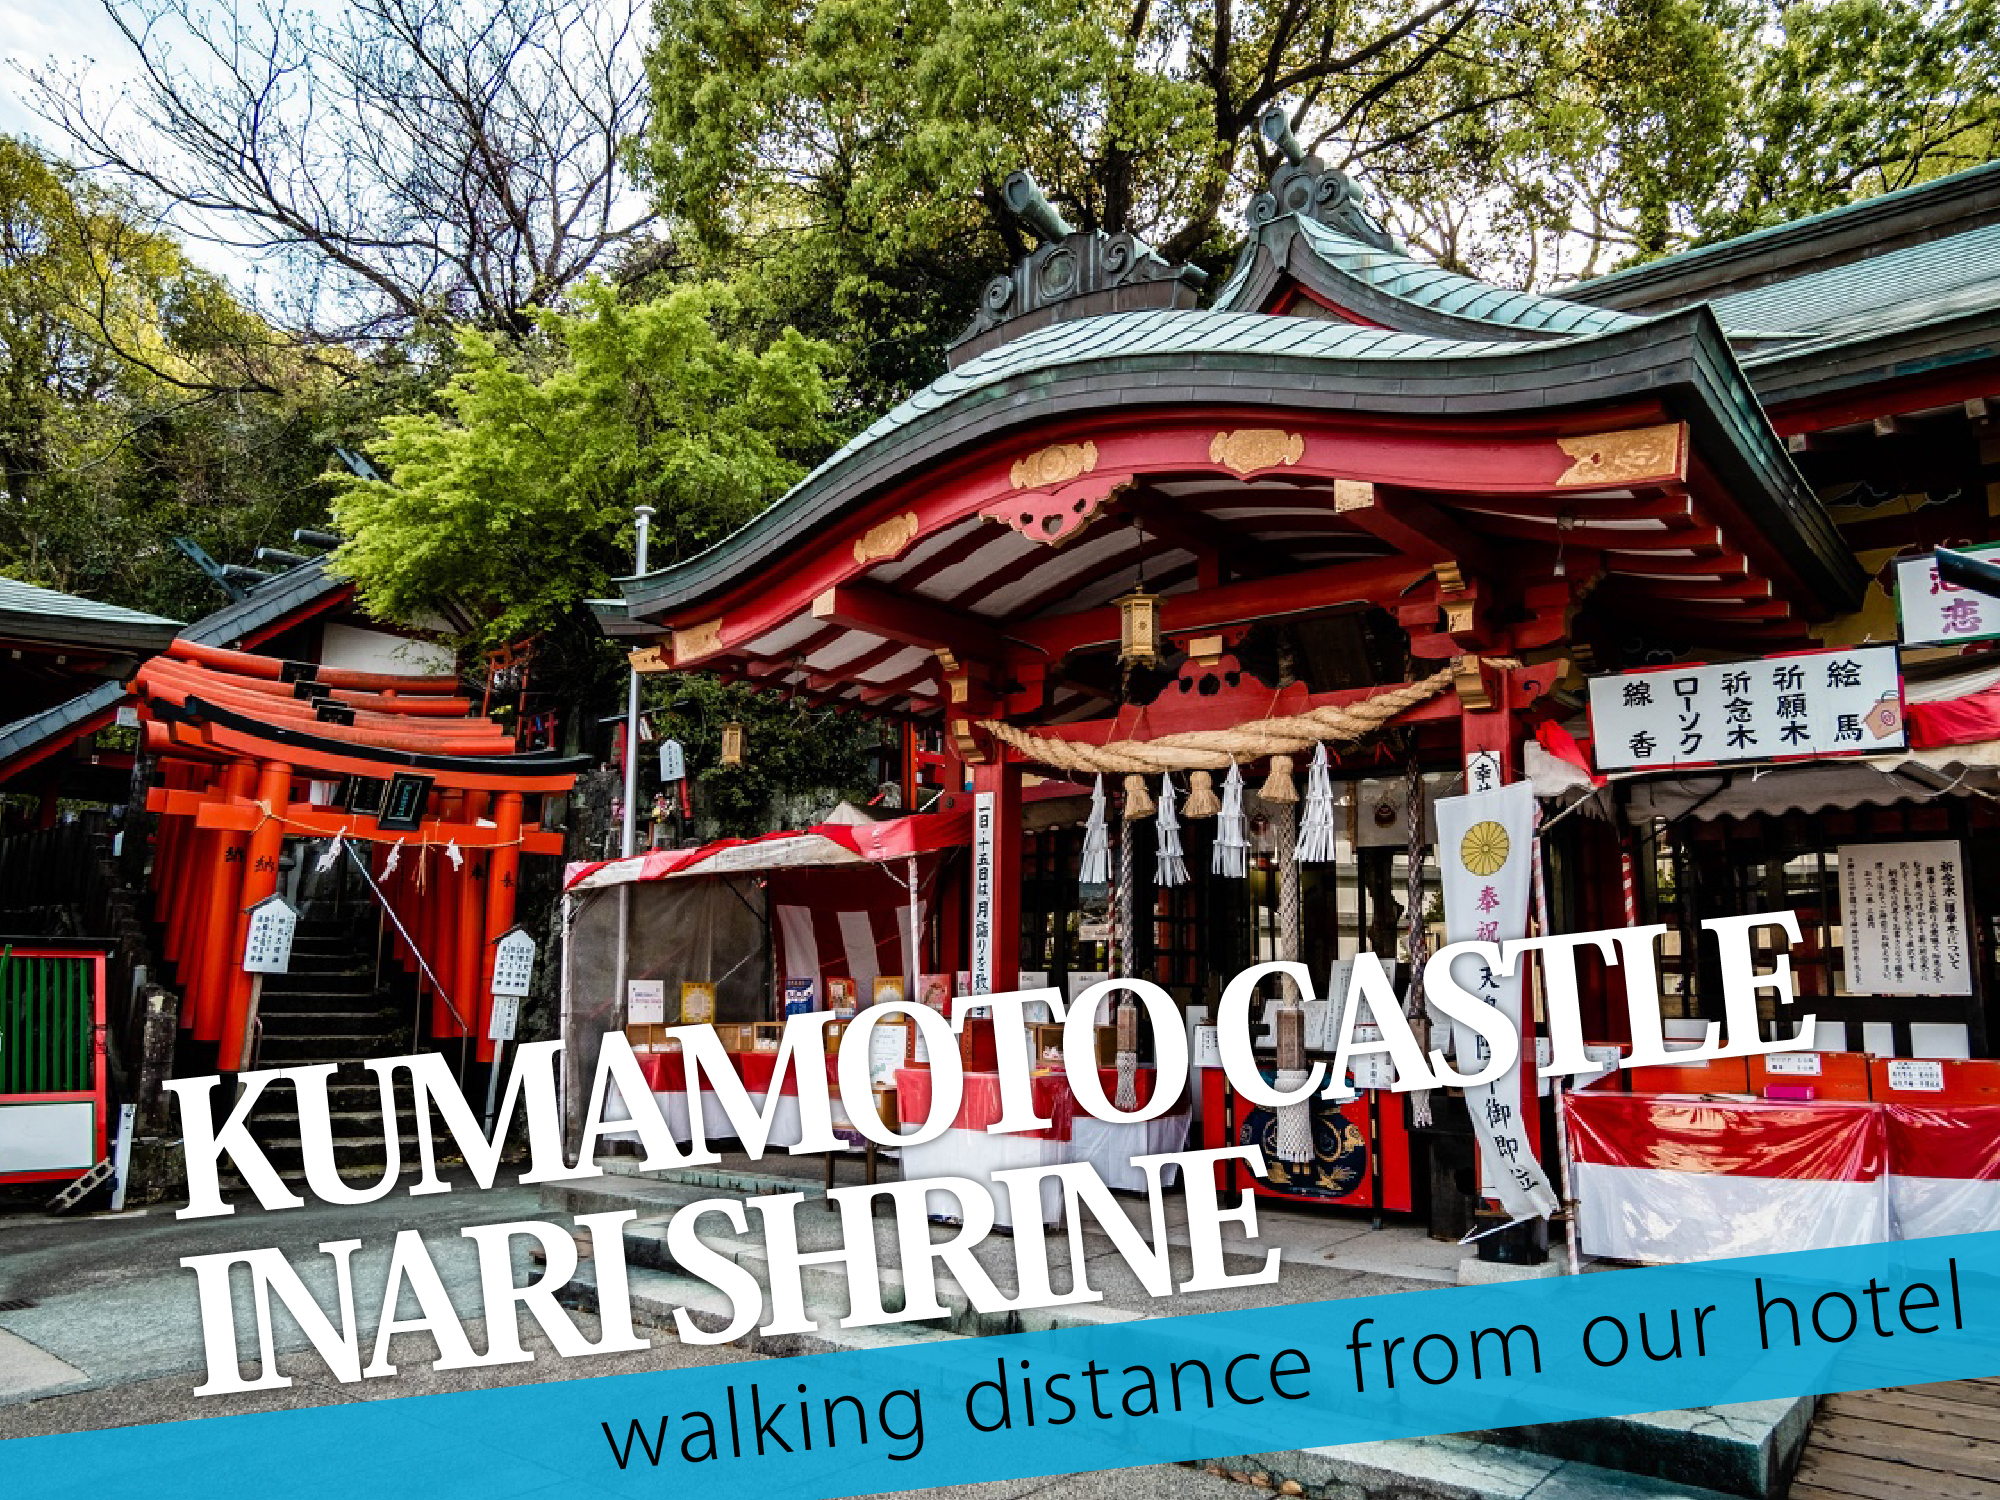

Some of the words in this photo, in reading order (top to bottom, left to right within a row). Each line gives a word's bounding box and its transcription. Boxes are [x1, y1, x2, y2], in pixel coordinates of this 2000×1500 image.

[1622, 680, 1657, 759] 線香
[1673, 677, 1703, 755] ローソク
[1721, 670, 1758, 749] 祈念木
[1773, 664, 1811, 746] 祈願木
[1826, 659, 1863, 743] 絵馬
